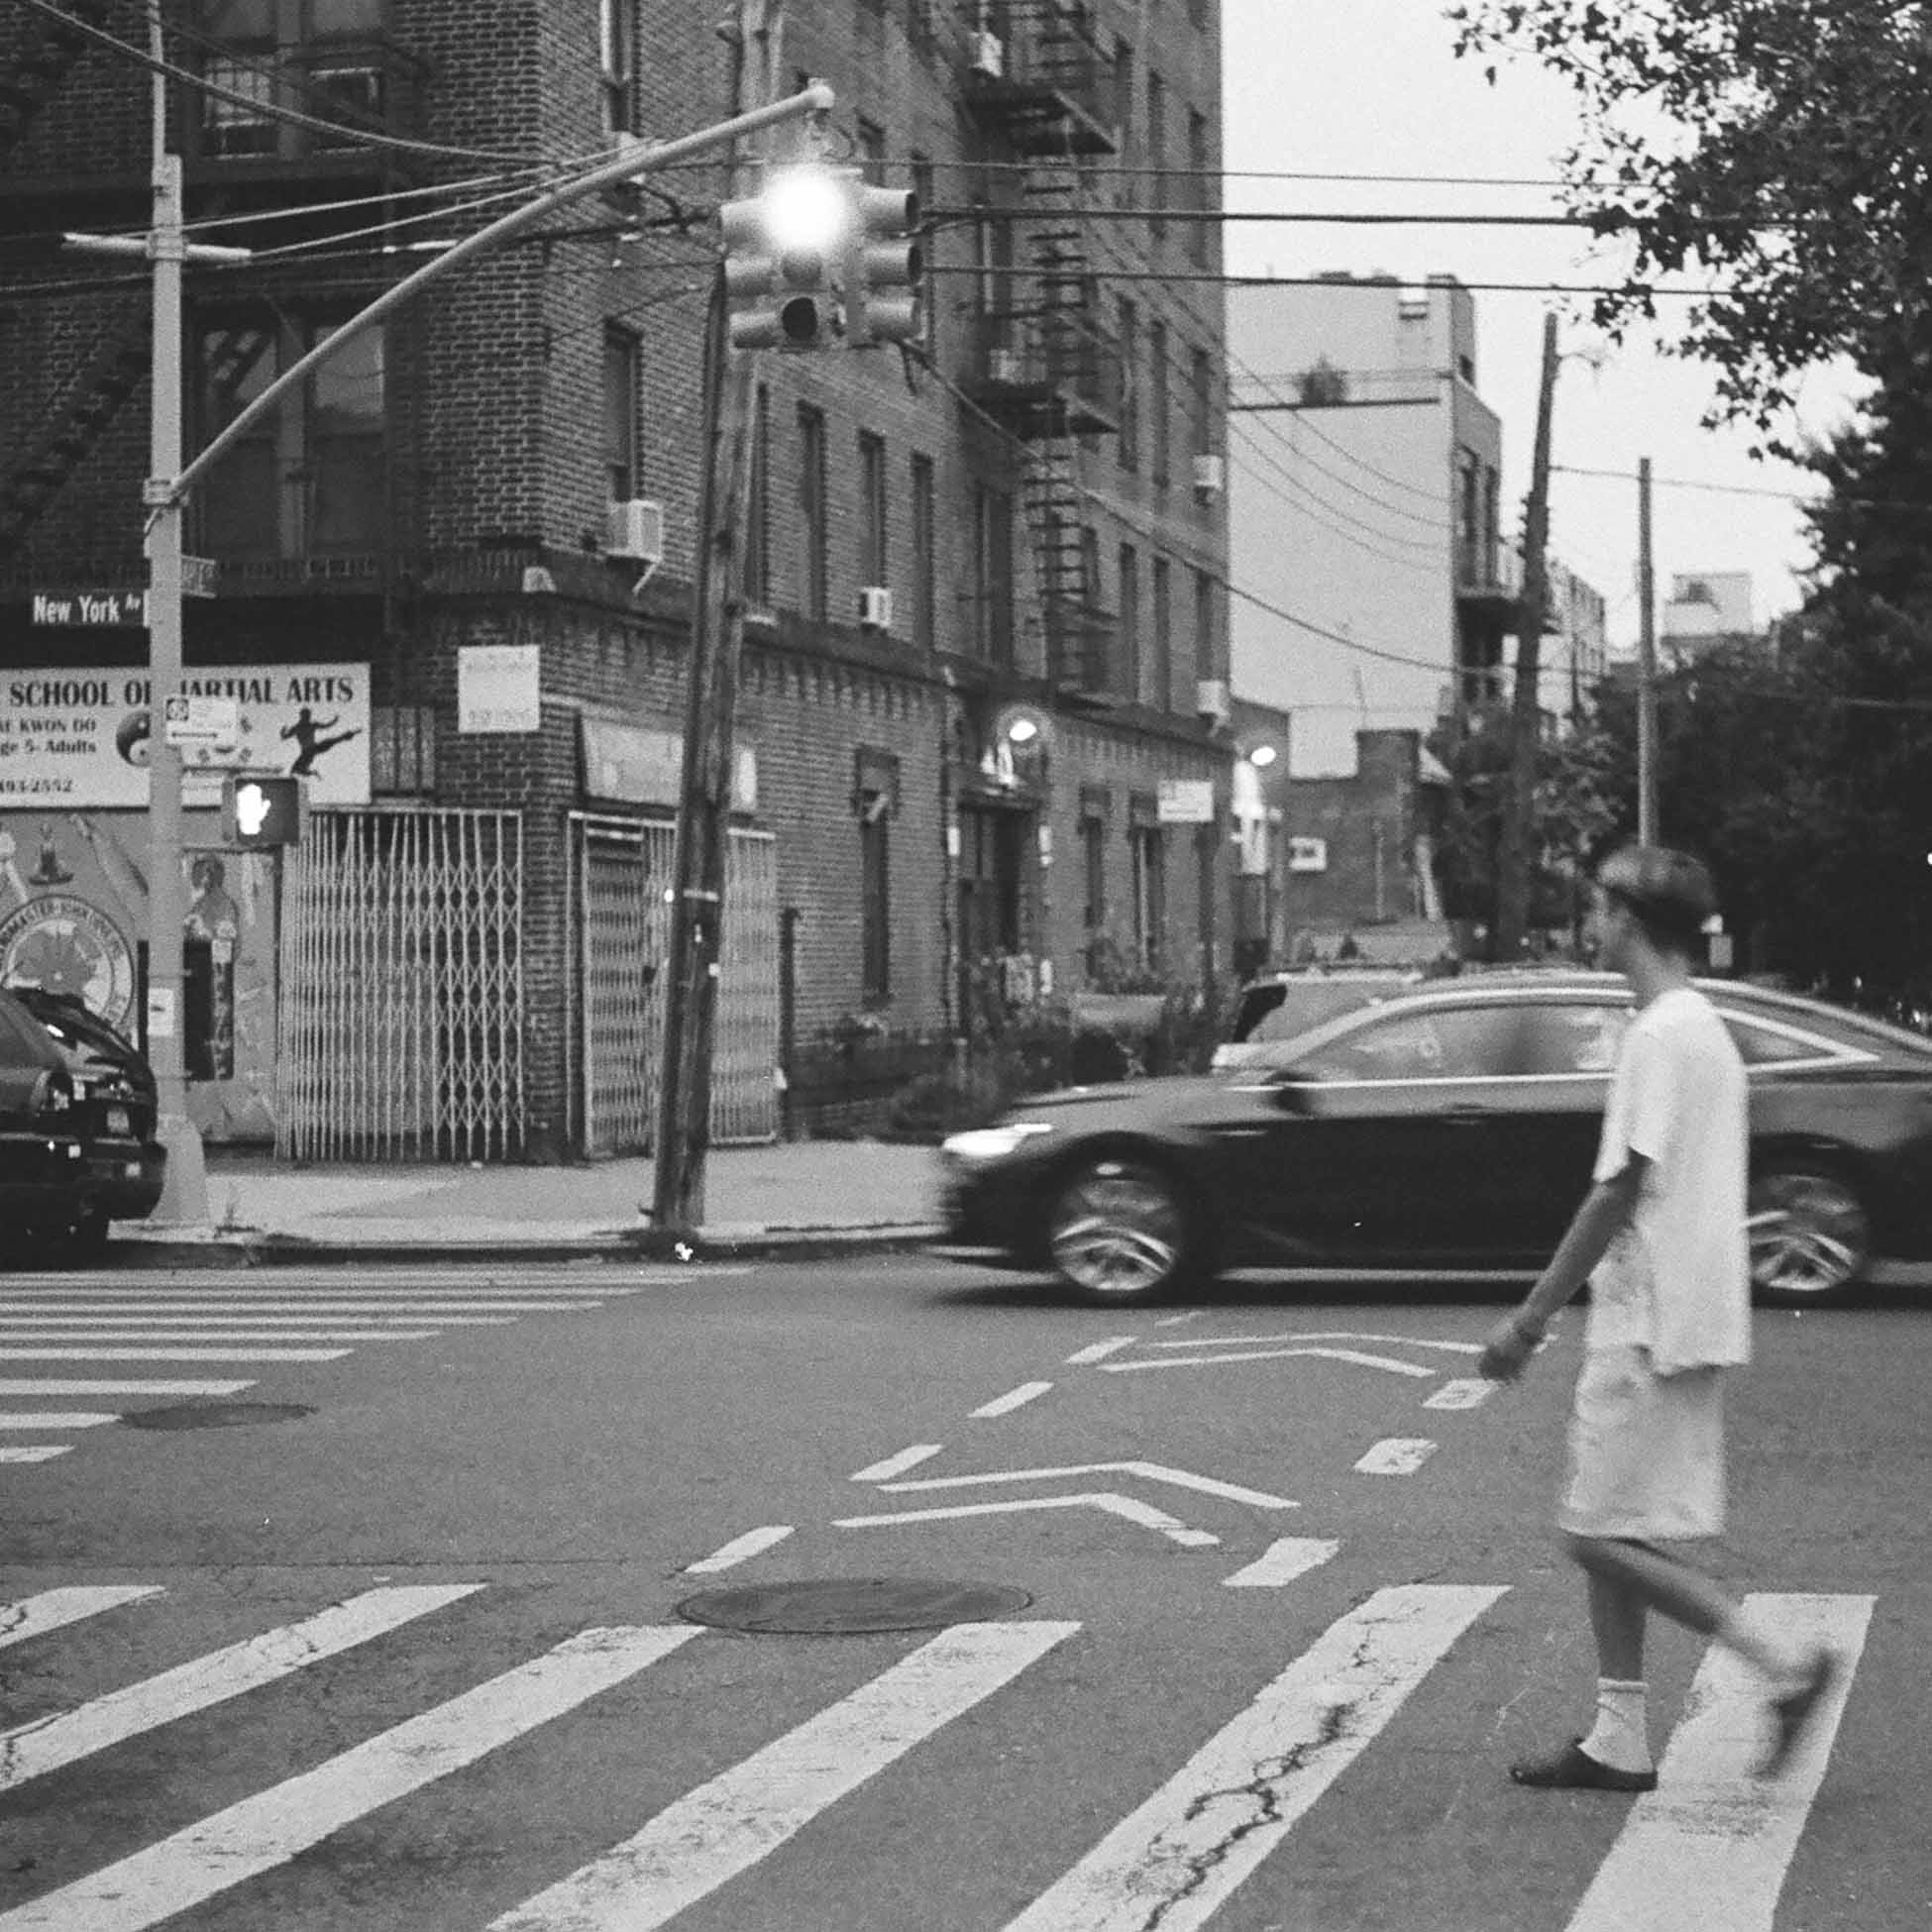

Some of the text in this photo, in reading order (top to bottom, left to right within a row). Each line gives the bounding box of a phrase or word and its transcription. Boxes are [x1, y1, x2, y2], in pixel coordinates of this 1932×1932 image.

[34, 594, 71, 623] New
[78, 594, 120, 623] York
[9, 680, 116, 706] SCHOOL
[180, 678, 278, 704] ARTIAL
[287, 677, 354, 703] ARTS
